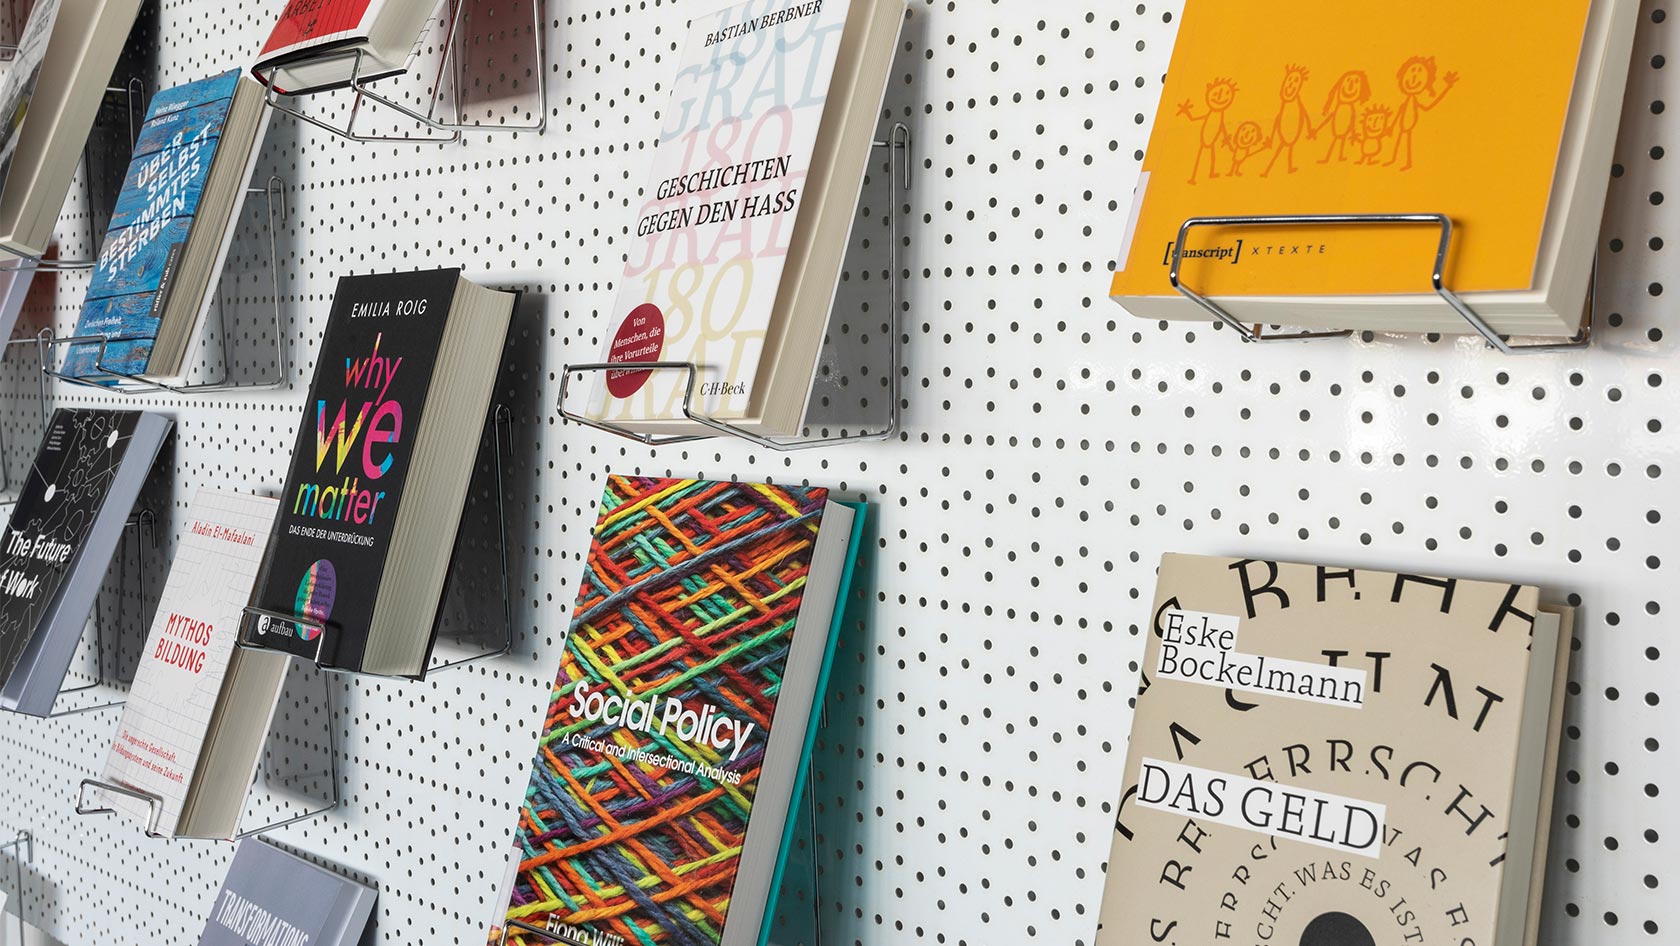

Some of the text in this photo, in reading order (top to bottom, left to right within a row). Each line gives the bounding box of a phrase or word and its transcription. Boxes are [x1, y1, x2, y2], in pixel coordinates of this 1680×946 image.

[284, 0, 332, 19] ARBEI
[704, 0, 823, 48] BASTIAN BERBNER
[137, 131, 183, 189] ÜBER
[146, 122, 212, 202] SELBST
[656, 154, 793, 201] GESCHICHTEN
[99, 156, 201, 273] BESTIMMTES
[107, 189, 187, 282] STERBEN
[637, 189, 798, 238] GEGEN DEN HASS
[351, 298, 428, 318] EMILIA ROIG
[633, 317, 646, 328] Von
[610, 343, 659, 363] ihre Vorurteile
[613, 326, 662, 349] Menschen, die
[345, 331, 403, 406] why
[316, 397, 404, 480] we
[293, 475, 386, 526] matter
[6, 530, 72, 563] The Future
[191, 520, 256, 547] Aladin El-Mafaalani
[289, 524, 375, 547] DAS ENDE DER UNTERDRÜCKUNG
[4, 569, 40, 599] Work
[165, 612, 214, 647] MYTHOS
[270, 620, 294, 637] aufbau
[1163, 613, 1235, 651] Eske
[154, 637, 206, 674] BILDUNG
[1157, 643, 1364, 704] Bockelmann
[569, 680, 756, 762] Social Policy
[561, 731, 742, 786] A Critical and Intersectional Analysis
[1138, 763, 1379, 850] DAS GELD
[1293, 860, 1352, 888] WAS
[1358, 867, 1392, 899] ES
[1388, 897, 1424, 944] IST
[545, 912, 590, 944] Fiona
